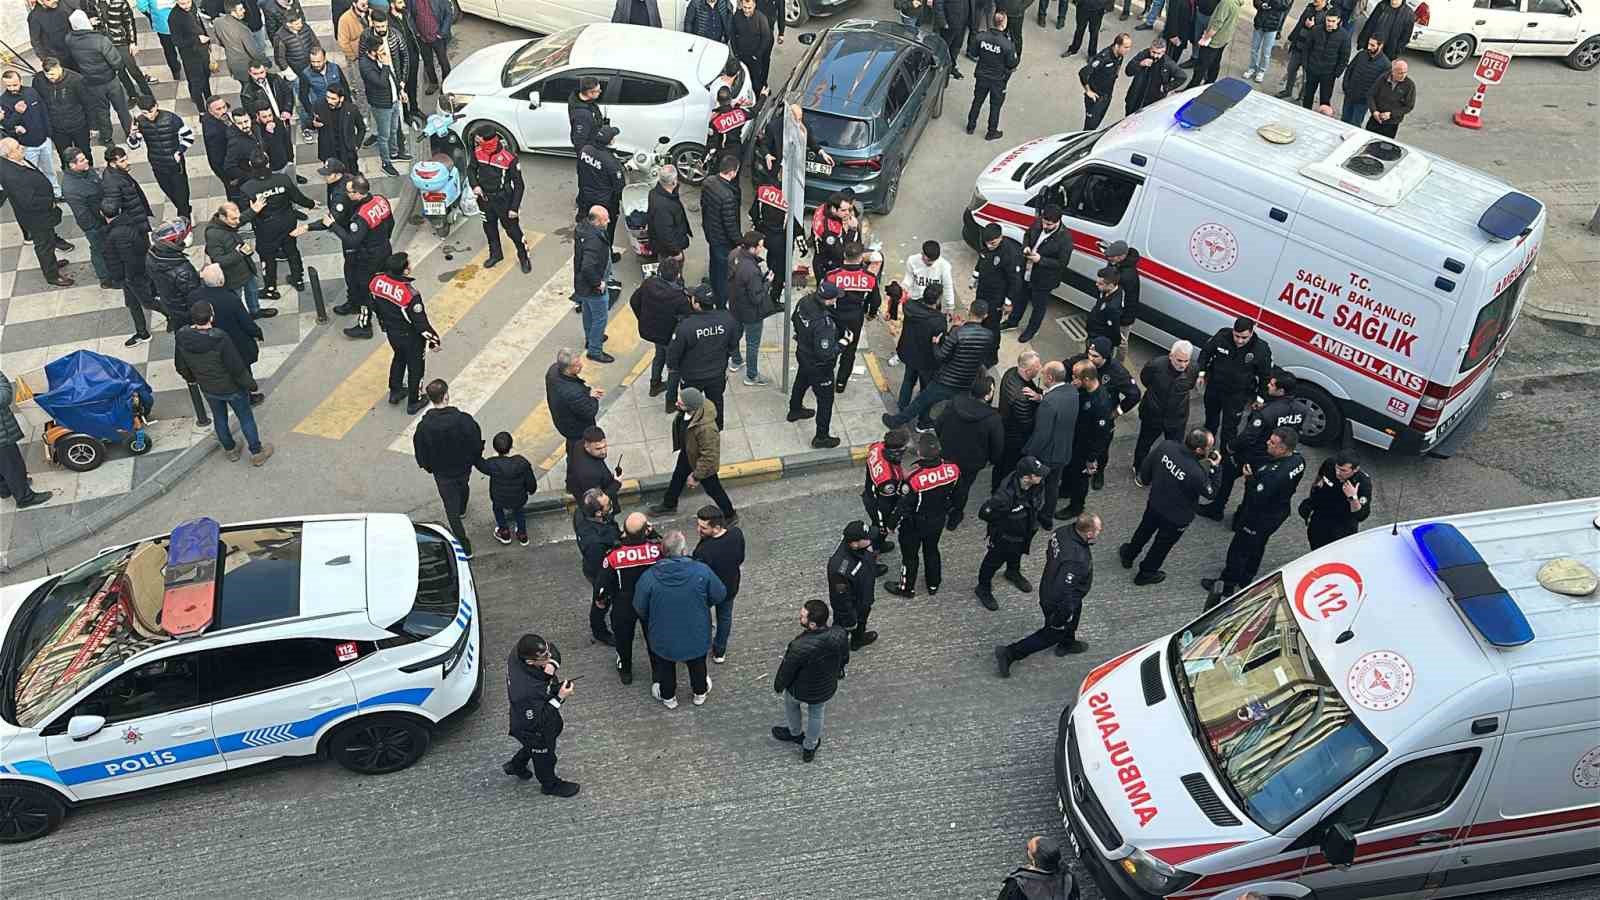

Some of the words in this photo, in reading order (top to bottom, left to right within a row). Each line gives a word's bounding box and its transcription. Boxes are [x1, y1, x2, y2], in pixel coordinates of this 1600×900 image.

[1481, 57, 1506, 72] OTEL
[719, 109, 745, 128] POLİS
[375, 278, 404, 301] POLİS
[835, 275, 869, 288] POLİS
[1348, 272, 1373, 292] T.C.
[1295, 269, 1343, 298] SAĞLIK
[1346, 289, 1417, 328] BAKANLIĞI
[695, 323, 726, 340] POLİS
[1332, 302, 1420, 359] SAĞLIK
[1308, 333, 1424, 392] AMBULANS
[1390, 398, 1409, 412] 112
[917, 464, 956, 487] POLİS
[1160, 454, 1187, 482] POLİS
[616, 543, 661, 563] POLİS
[1313, 583, 1348, 619] 112
[103, 750, 177, 776] POLİS
